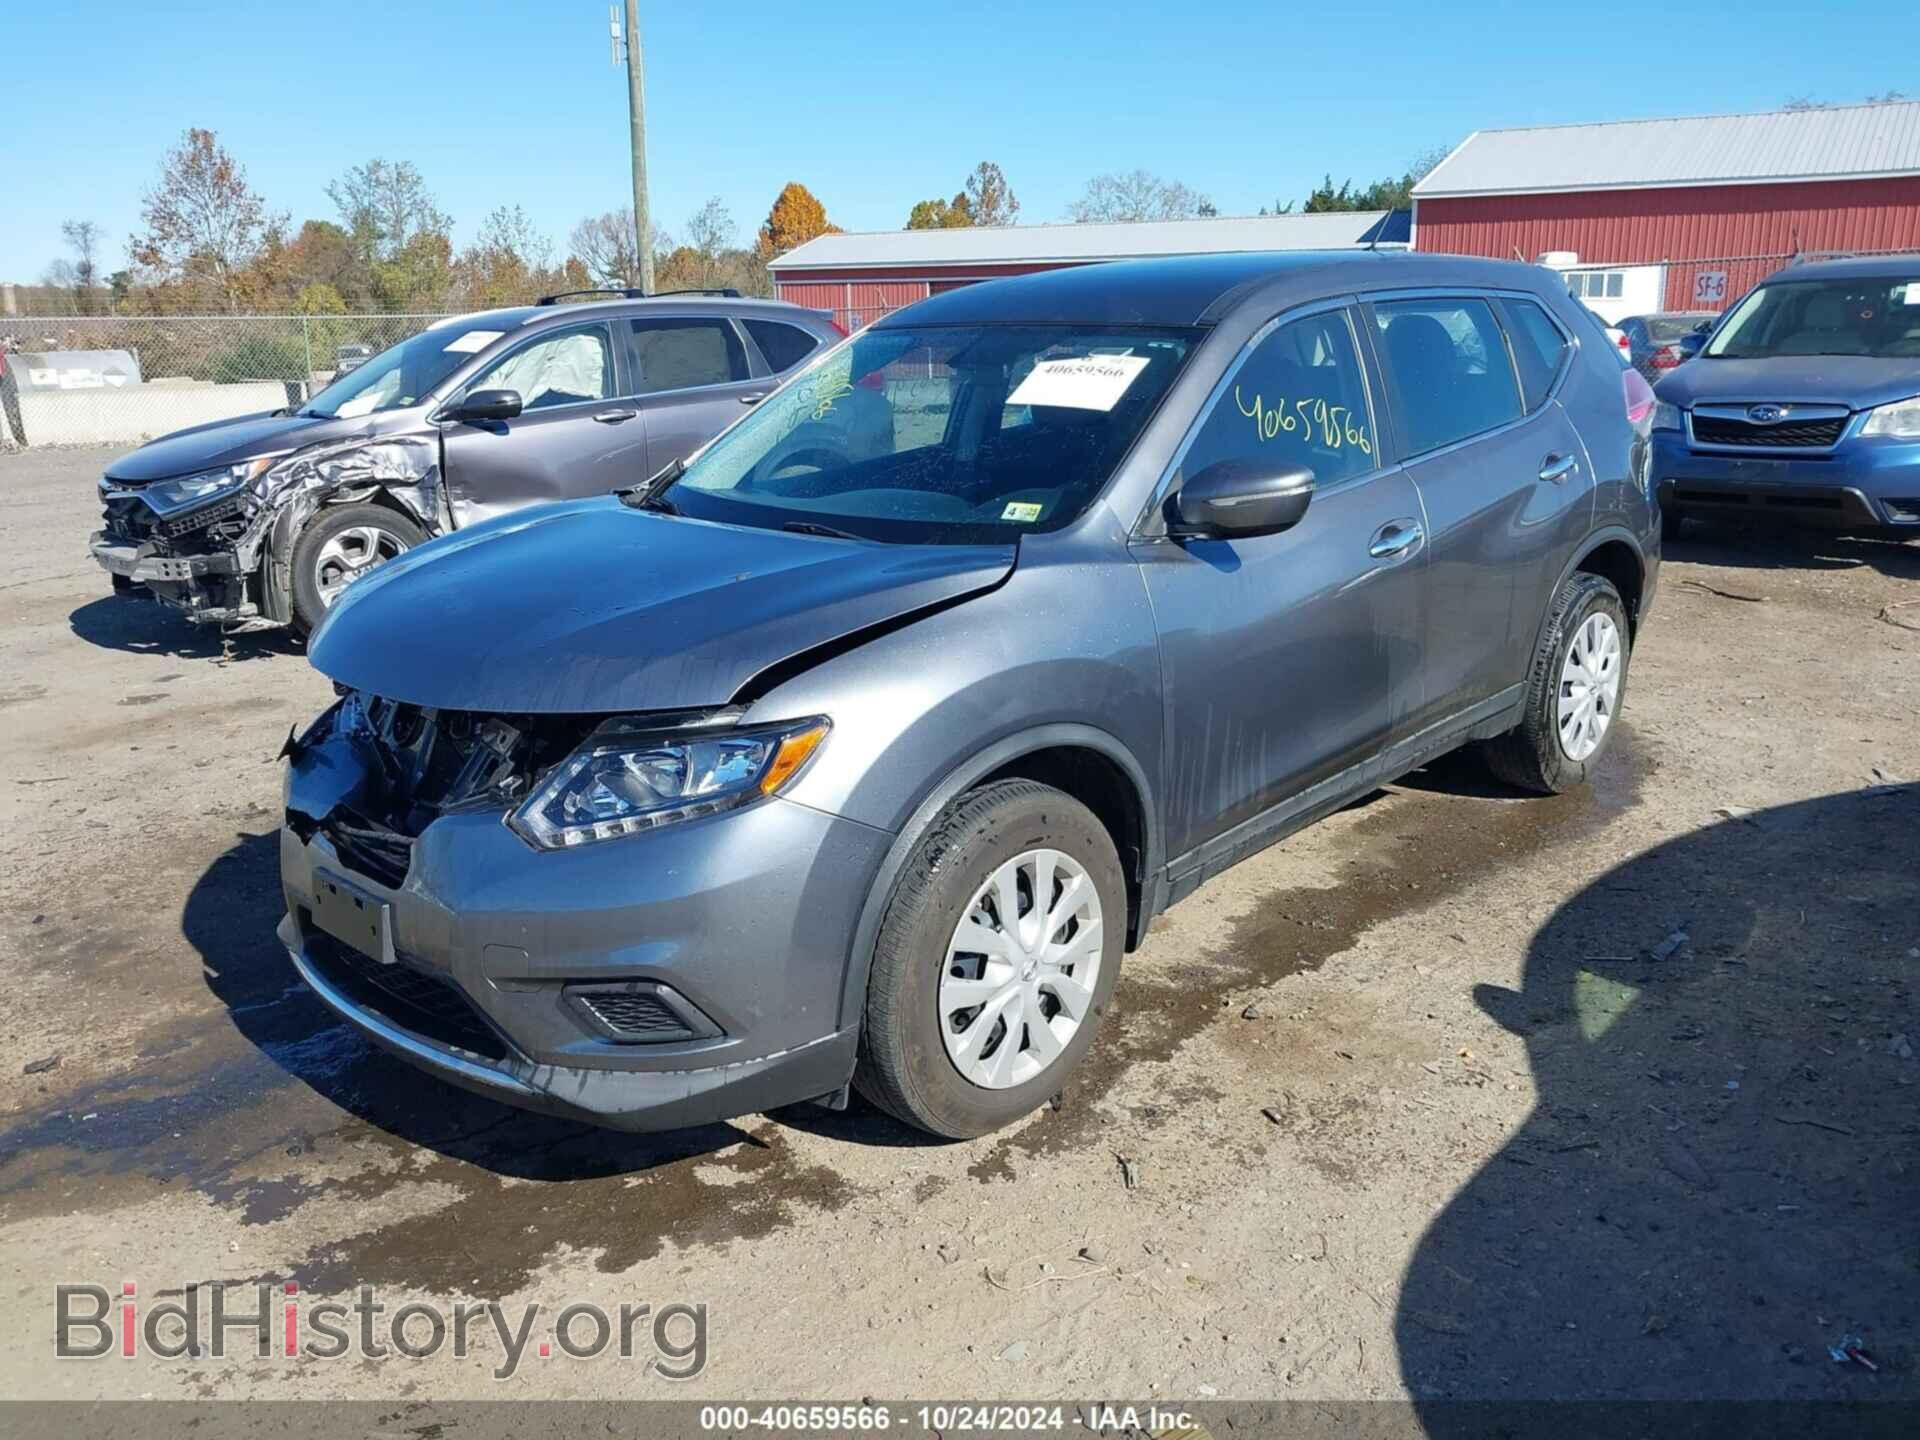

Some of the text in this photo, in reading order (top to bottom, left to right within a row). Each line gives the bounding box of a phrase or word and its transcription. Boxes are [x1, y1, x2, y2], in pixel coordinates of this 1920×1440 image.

[1696, 276, 1725, 297] SF-6
[1044, 365, 1125, 376] 40659566
[1235, 385, 1371, 454] 40659566
